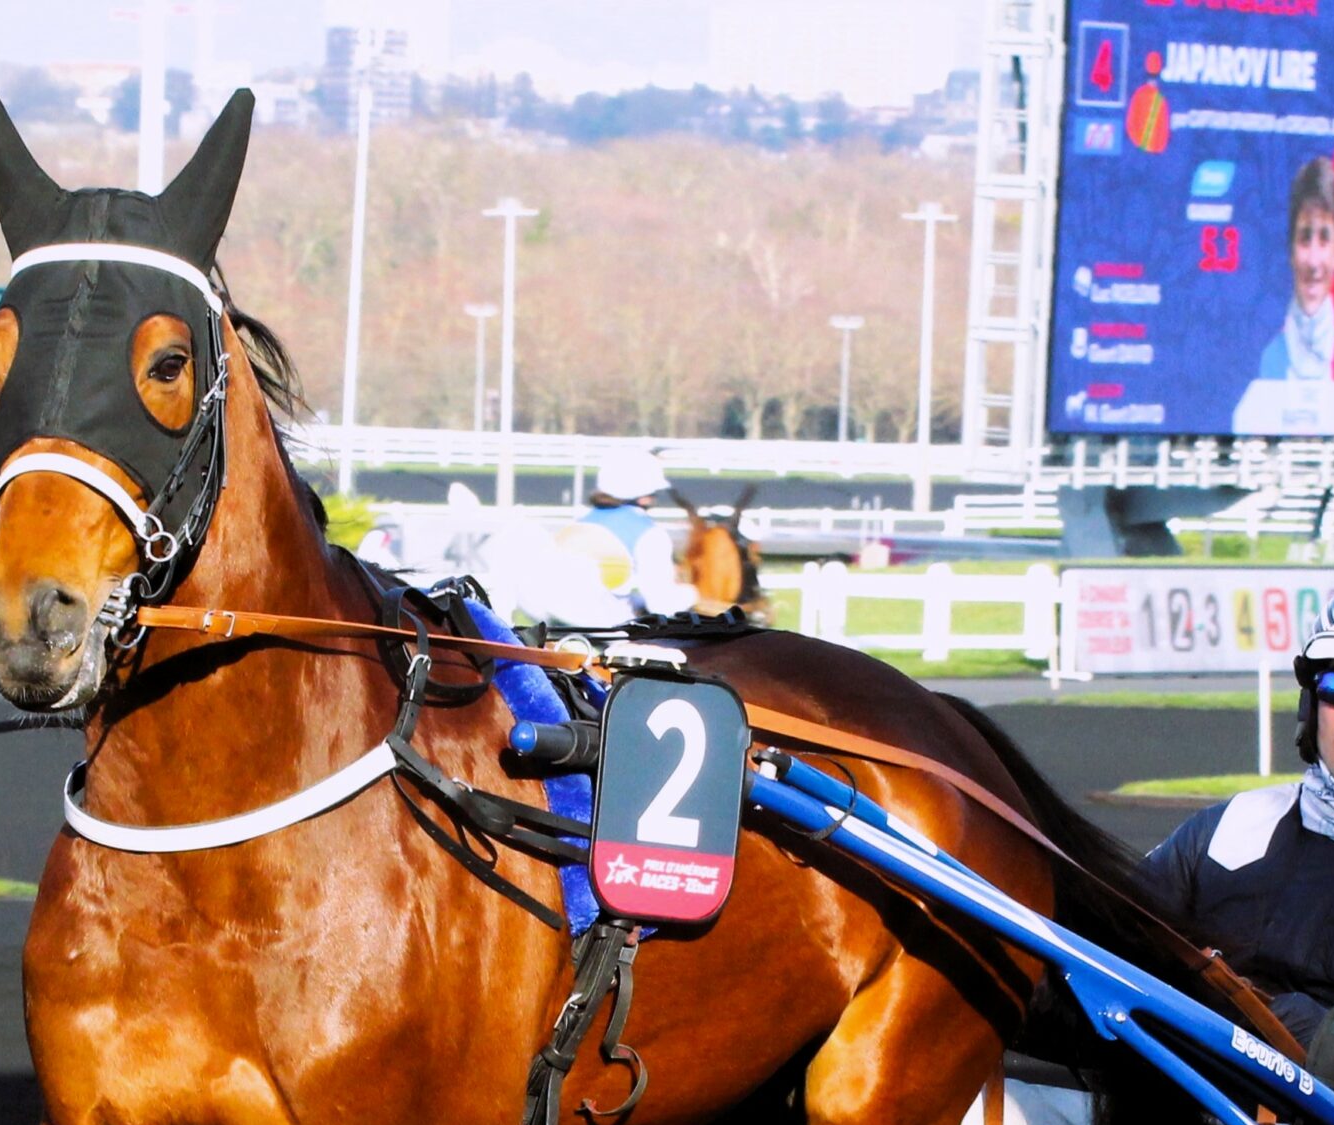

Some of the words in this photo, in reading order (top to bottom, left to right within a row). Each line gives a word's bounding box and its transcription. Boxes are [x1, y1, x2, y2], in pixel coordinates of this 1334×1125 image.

[1090, 39, 1114, 92] 4
[1160, 42, 1268, 87] JAPAROV
[1267, 48, 1317, 91] LIRE
[1141, 592, 1157, 649] 1
[1169, 588, 1194, 651] 2
[1204, 594, 1219, 647] 3
[1234, 590, 1256, 650] 4
[1262, 588, 1291, 651] 5
[636, 699, 707, 848] 2
[643, 859, 666, 873] PRIX
